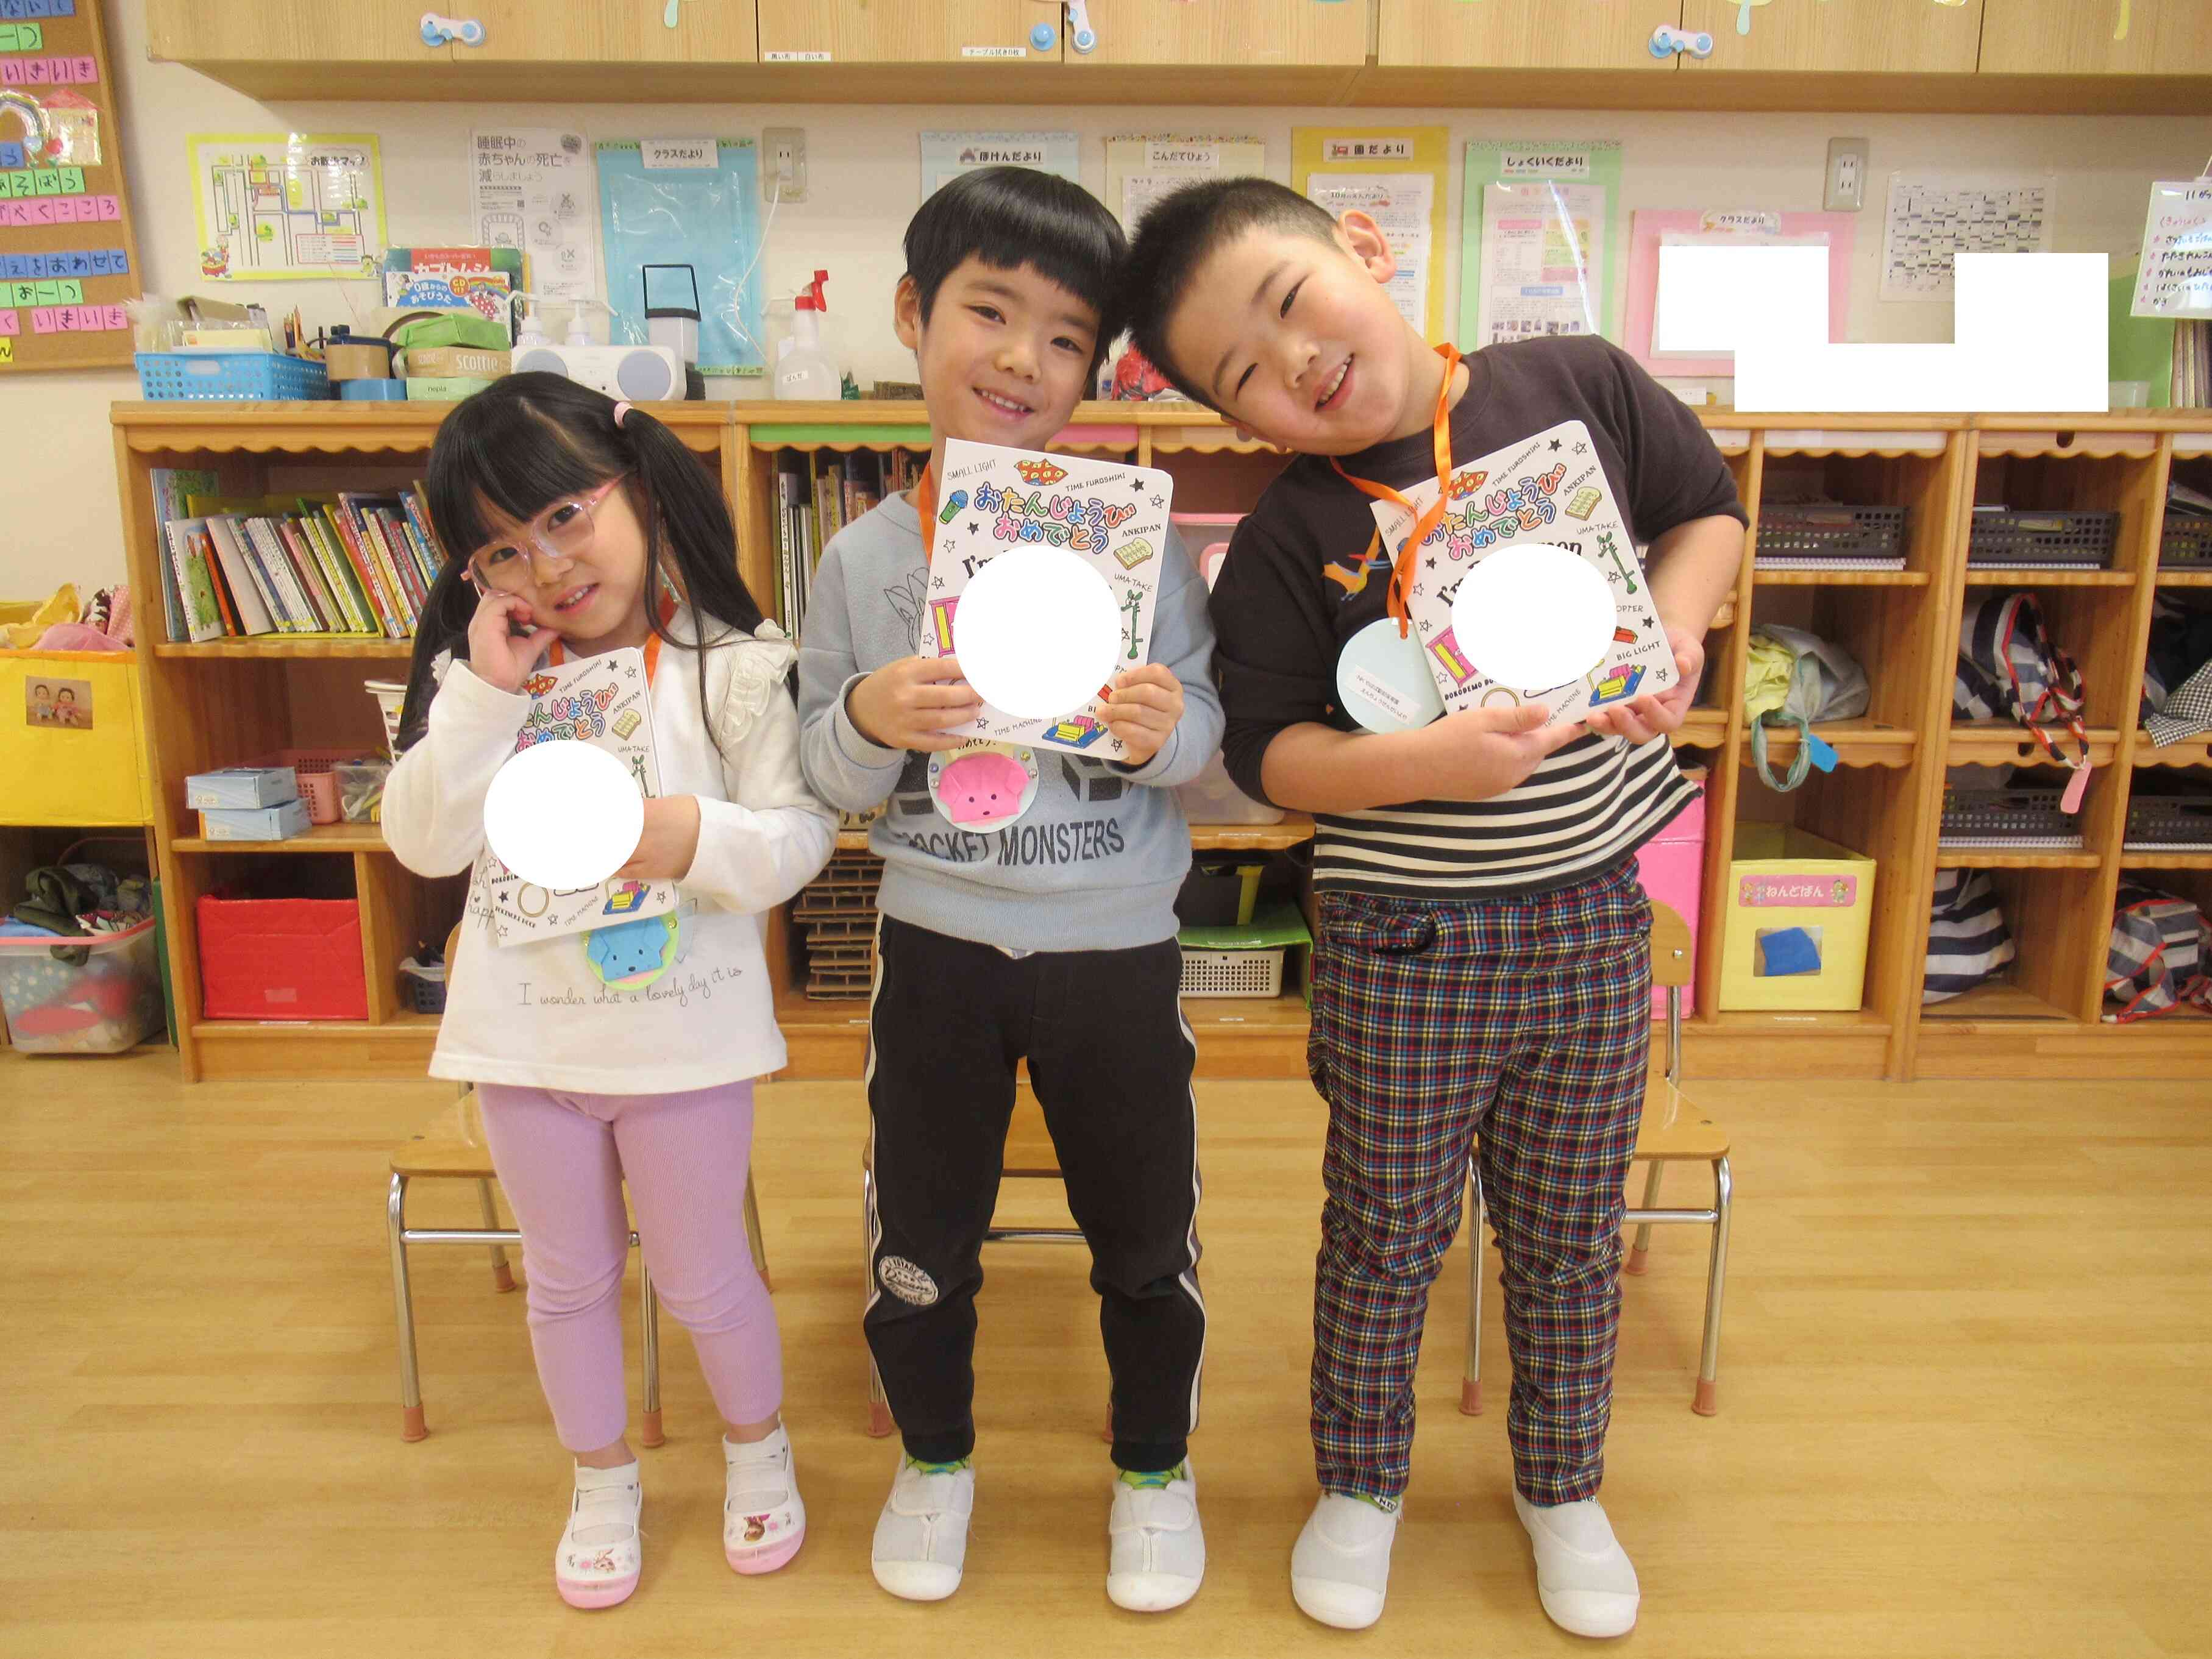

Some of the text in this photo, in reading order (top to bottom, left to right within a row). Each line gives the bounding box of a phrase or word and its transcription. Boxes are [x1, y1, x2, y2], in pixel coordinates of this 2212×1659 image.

[5, 60, 90, 81] いきいき
[478, 136, 527, 150] 睡眠中の
[1354, 144, 1404, 155] 園だより
[654, 149, 702, 159] クラスだより
[980, 151, 1041, 162] ほけんだより
[1153, 151, 1210, 162] こんだてひょう
[1507, 156, 1583, 166] しょくいくだより
[35, 308, 122, 329] いきいき
[947, 459, 997, 480] SMALL LIGHT
[1492, 473, 1507, 486] TIME
[1066, 482, 1084, 492] TIME
[1563, 465, 1597, 496] ANKIPAN
[975, 481, 1137, 529] おたんじょうび
[993, 511, 1109, 554] おめでとう
[1122, 524, 1161, 538] ANKIPAN
[1385, 516, 1406, 537] SMALL
[1447, 497, 1556, 561] おめでとう
[1616, 642, 1661, 661] BIG LIGHT
[559, 681, 572, 693] TIME
[613, 691, 641, 714] ANKIPAN
[1557, 688, 1581, 714] MACHINE
[995, 728, 1010, 737] TIME
[997, 818, 1125, 866] MONSTERS
[518, 982, 532, 1005] I
[540, 987, 586, 1005] wonder
[594, 983, 622, 1004] what
[630, 993, 639, 1004] a
[644, 977, 688, 1007] lovely
[688, 974, 711, 999] day
[712, 968, 725, 984] it
